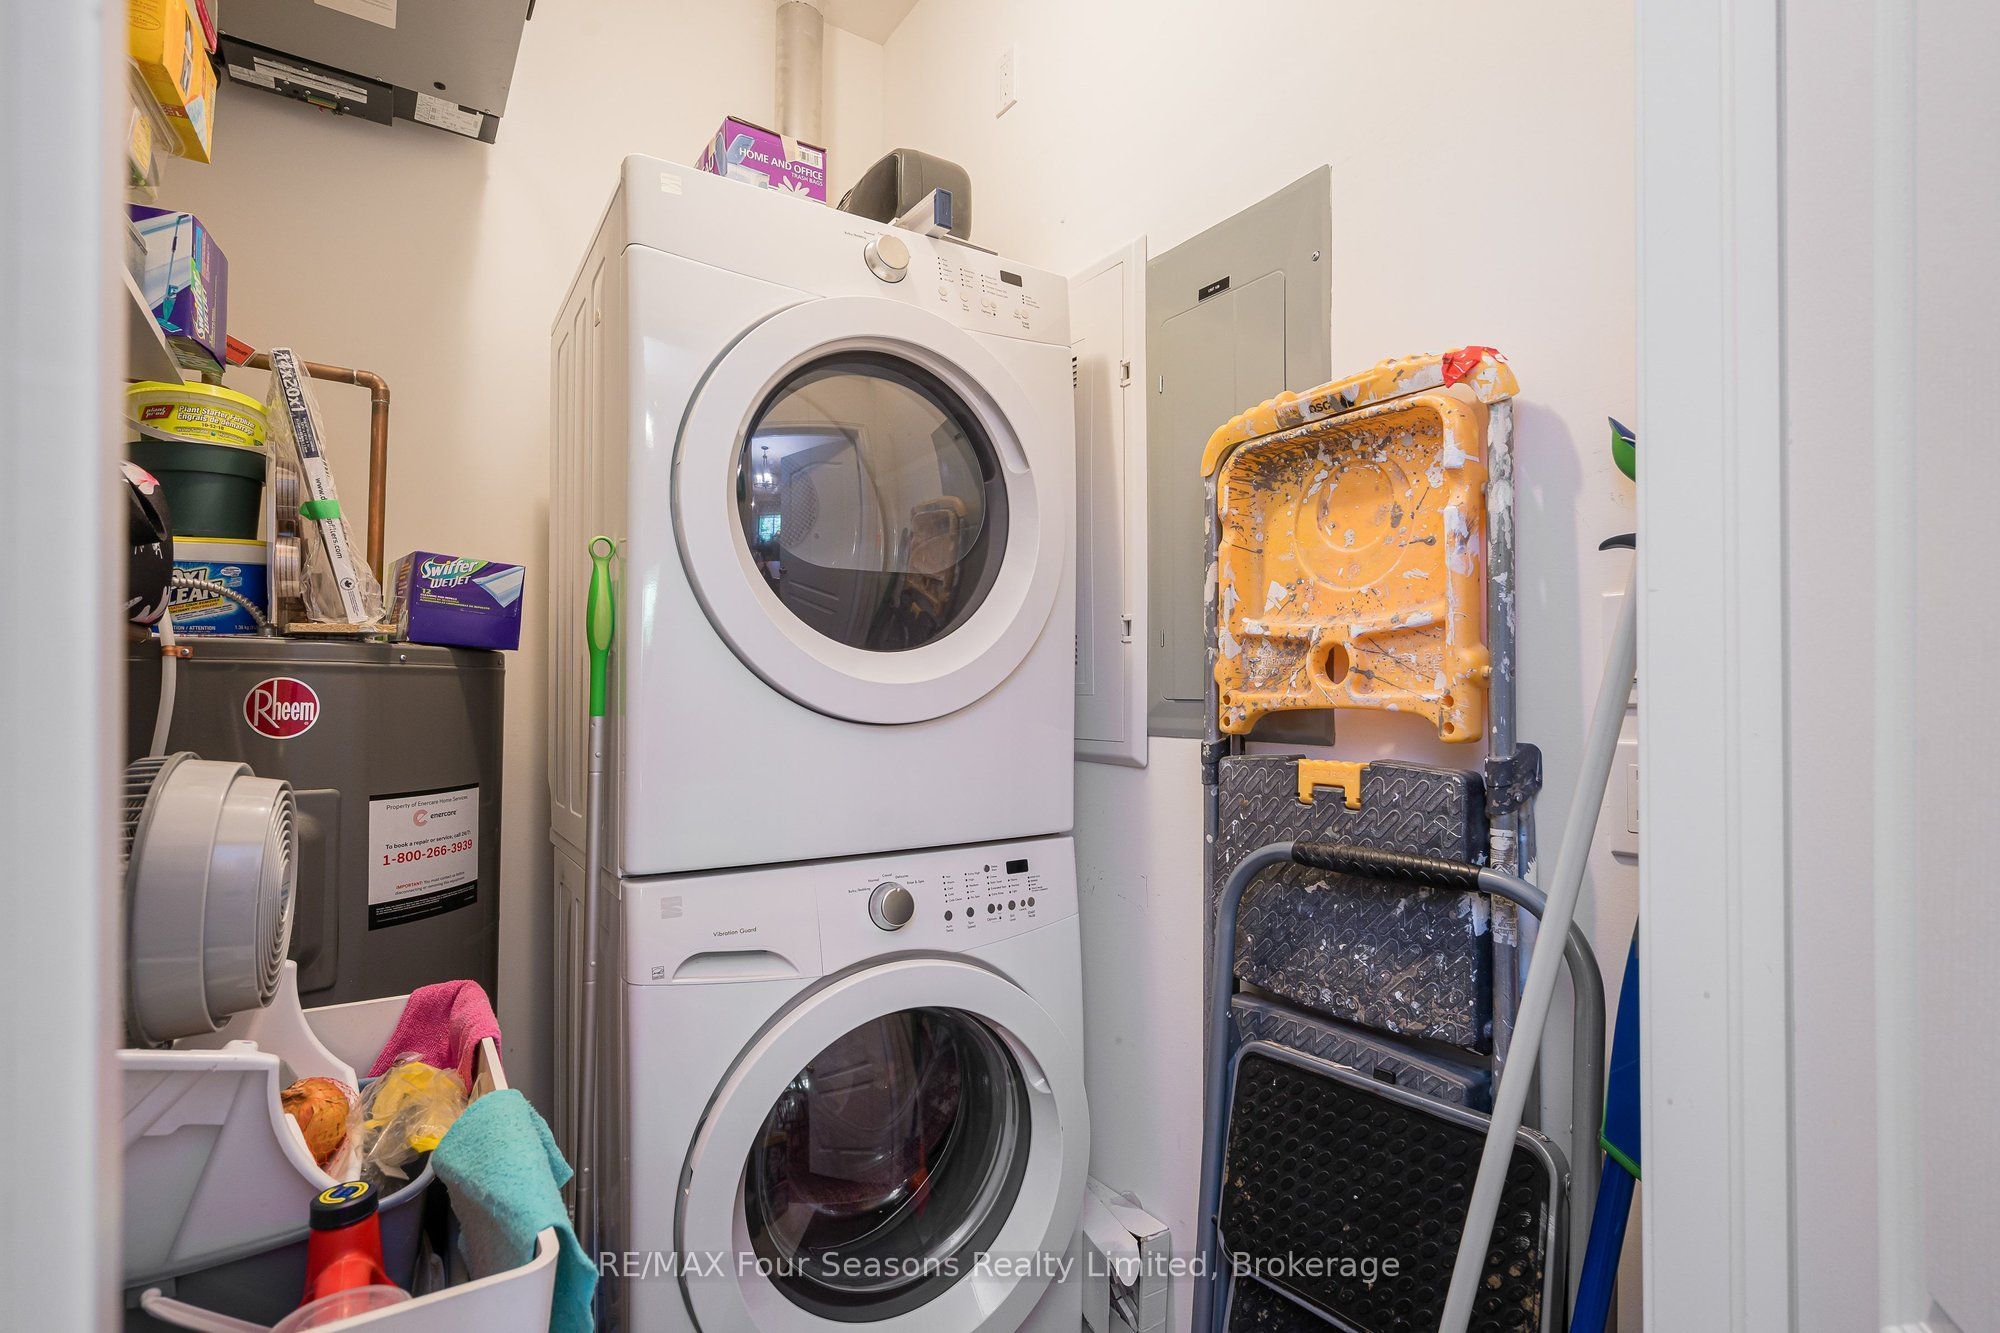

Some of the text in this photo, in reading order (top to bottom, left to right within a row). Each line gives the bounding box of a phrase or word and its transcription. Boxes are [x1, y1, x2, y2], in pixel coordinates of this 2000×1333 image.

[740, 147, 823, 181] HOME AND OFFICE
[791, 172, 823, 187] TRASH BAGS
[146, 411, 166, 419] prod
[177, 412, 208, 423] Engrais
[178, 404, 200, 414] Plant
[202, 407, 229, 420] Starter
[421, 559, 478, 579] Swiffer
[430, 575, 472, 589] WETJET
[254, 680, 315, 729] Rheem
[386, 802, 410, 810] Property
[411, 800, 417, 808] of
[418, 799, 439, 807] Enercare
[430, 810, 457, 819] enercare
[394, 841, 408, 849] book
[413, 838, 430, 847] repair
[436, 834, 454, 842] service,
[383, 839, 473, 866] 1-800-266-3939
[713, 926, 757, 937] Vibration Guard
